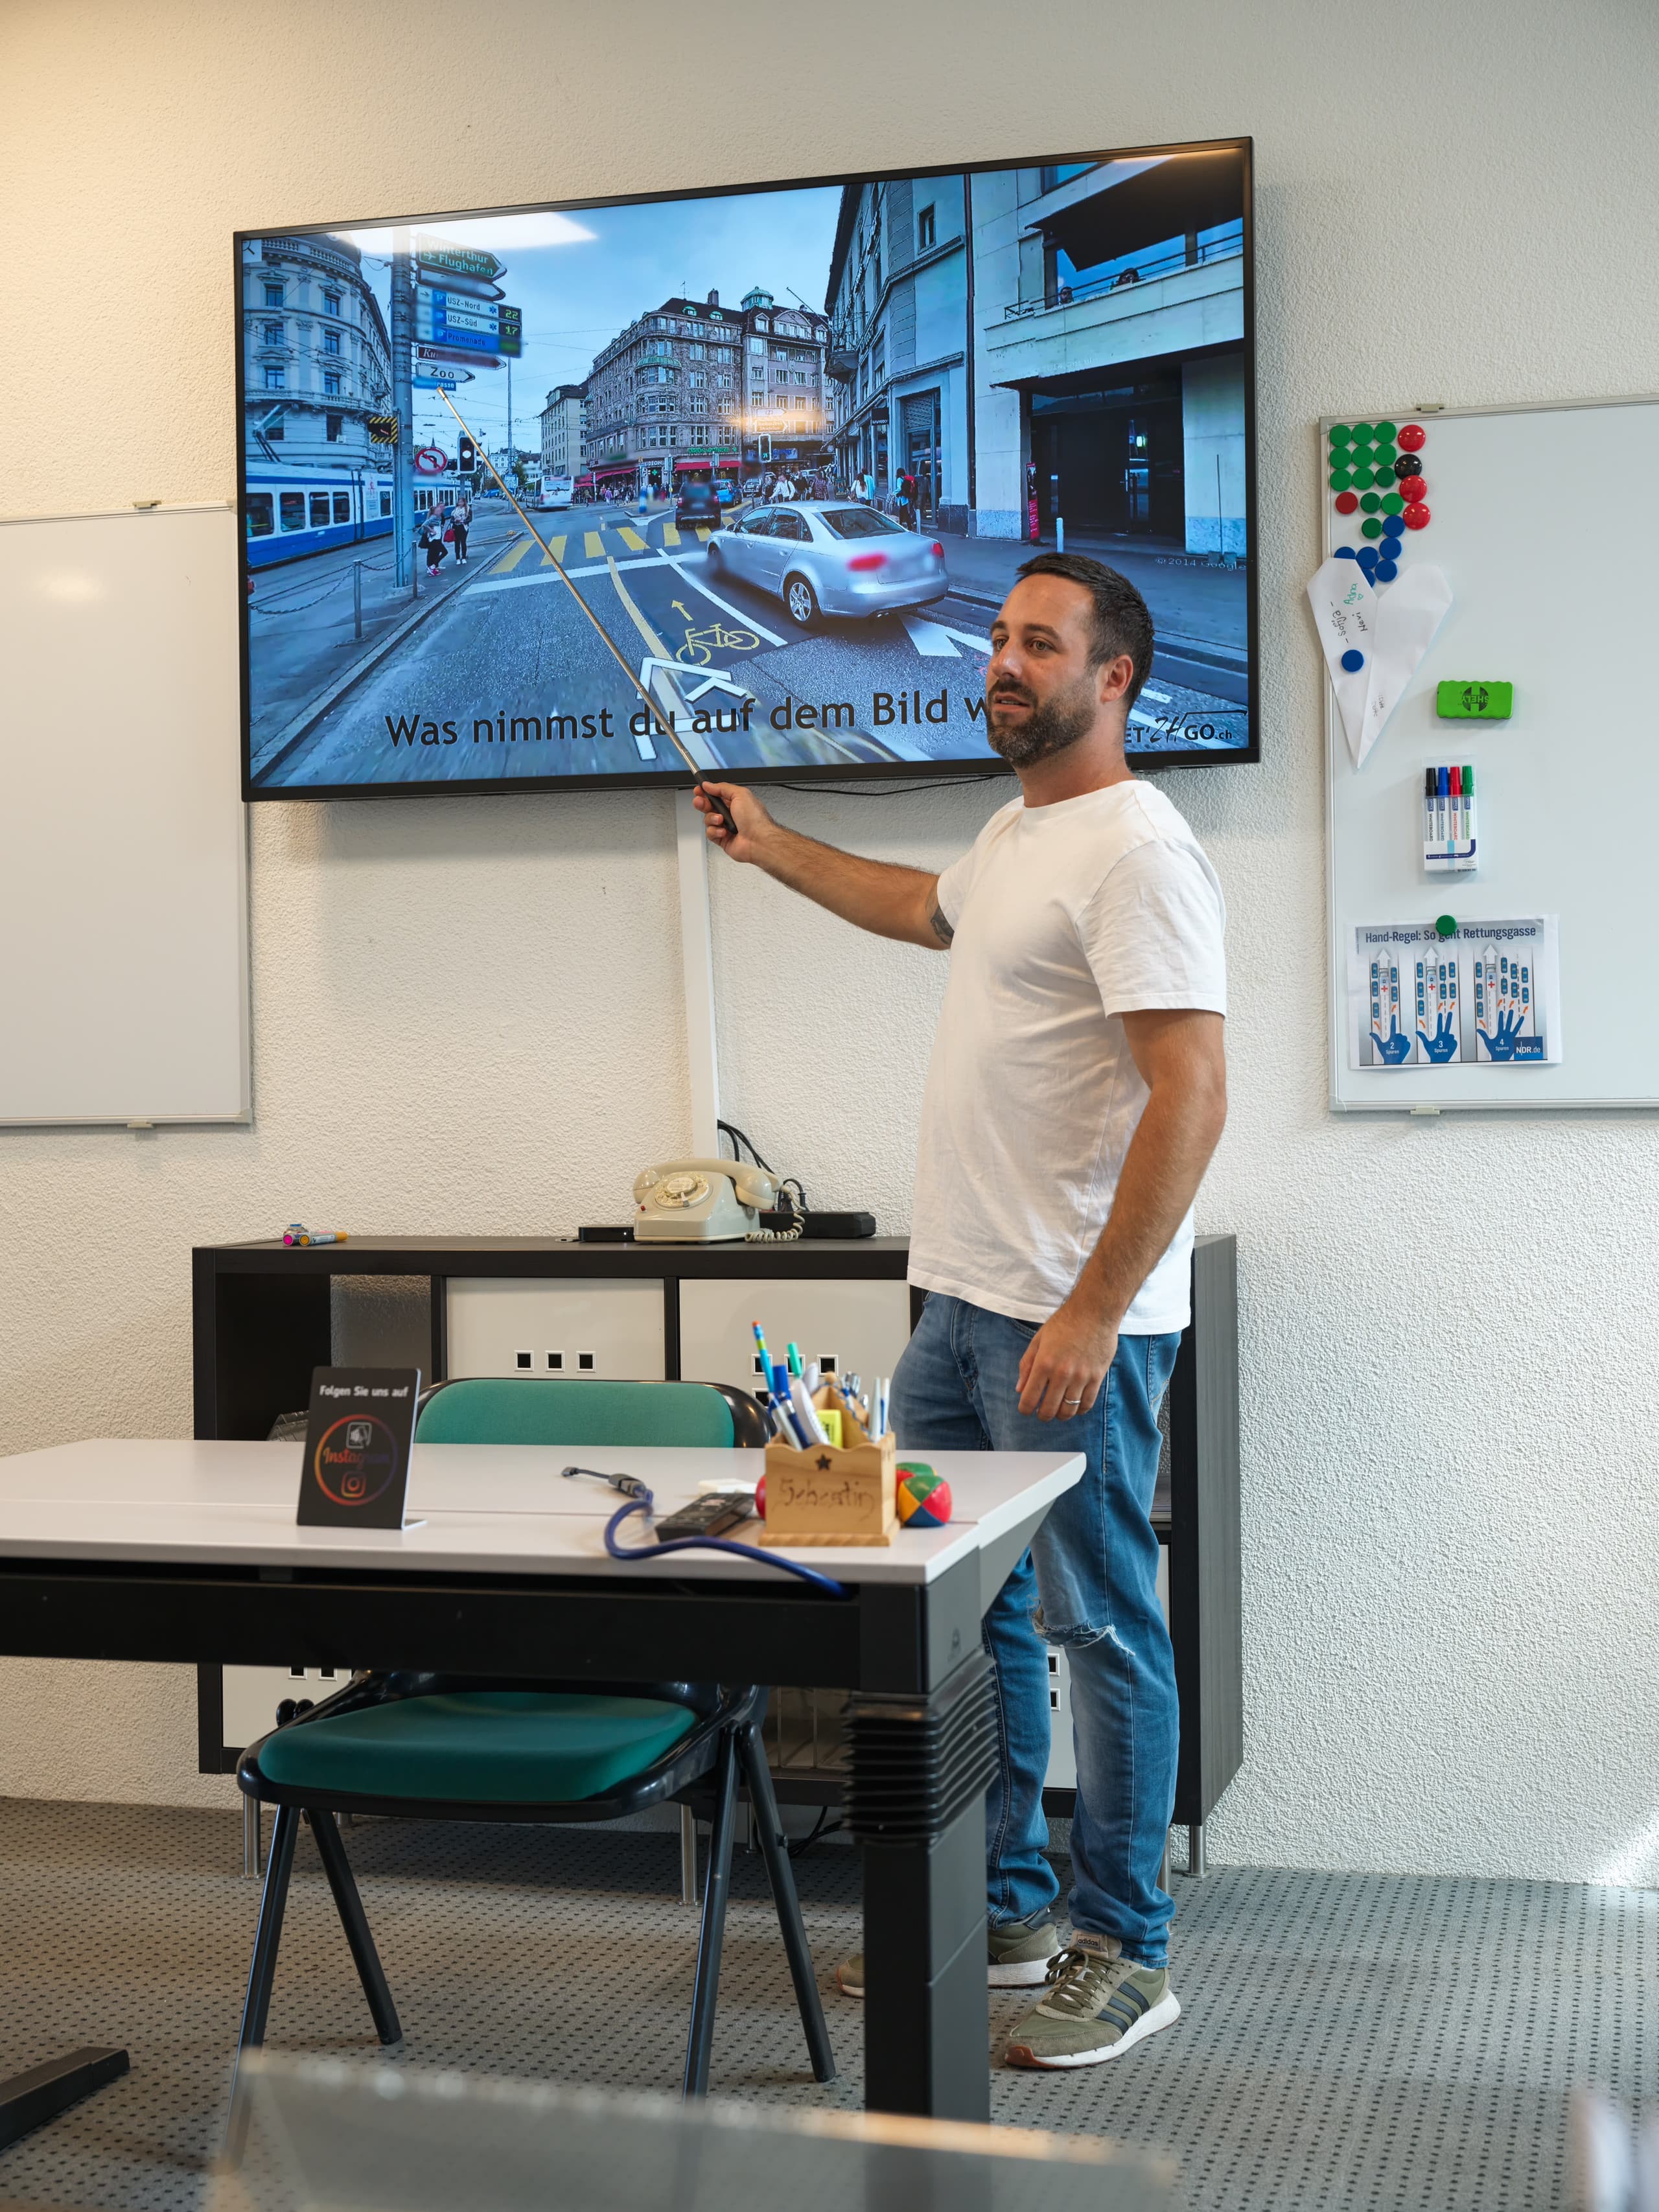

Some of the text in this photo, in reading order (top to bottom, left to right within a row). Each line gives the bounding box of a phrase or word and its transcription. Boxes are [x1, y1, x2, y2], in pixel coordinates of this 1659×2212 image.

[430, 367, 454, 379] Zoo
[384, 714, 458, 747] Was
[473, 707, 614, 743] nimmst
[691, 697, 756, 734] auf
[769, 695, 855, 730] dem
[872, 688, 948, 727] Bild
[1365, 929, 1422, 944] Hand-Regel:
[1424, 930, 1436, 941] So
[1463, 927, 1537, 940] Rettungsgasse
[1516, 1045, 1541, 1054] NDR.de
[319, 1384, 409, 1398] Folgen Sie uns auf
[1078, 1938, 1098, 1946] adidas
